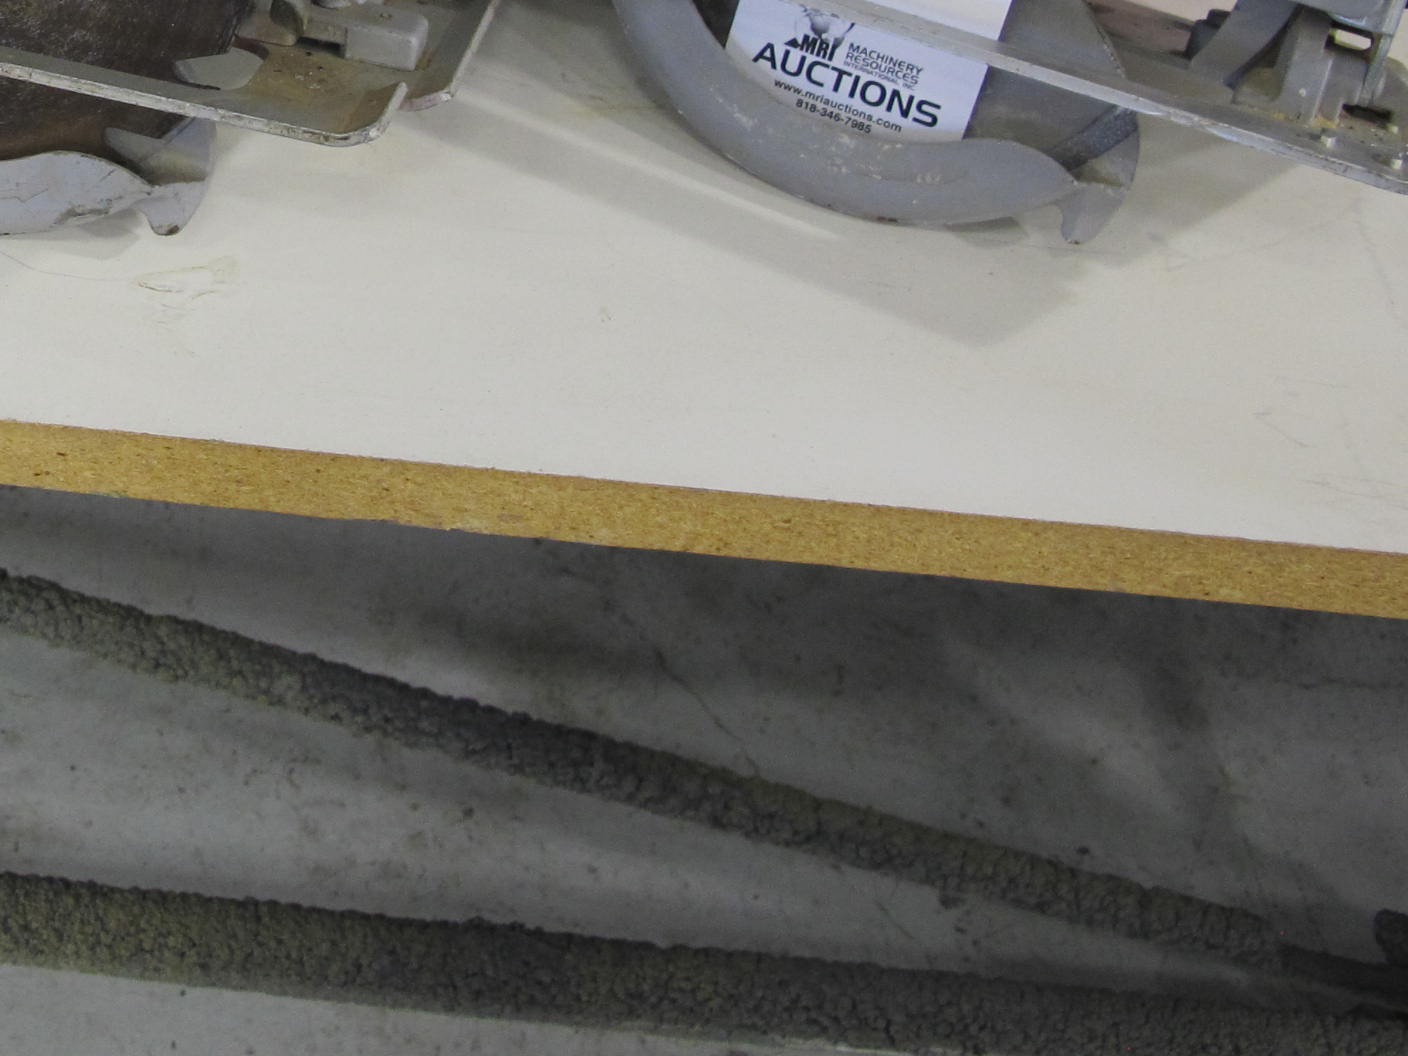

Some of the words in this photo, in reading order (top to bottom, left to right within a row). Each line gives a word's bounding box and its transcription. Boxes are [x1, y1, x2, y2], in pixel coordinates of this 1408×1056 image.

[799, 34, 842, 62] MRI
[848, 42, 924, 74] MACHINERY
[752, 42, 942, 128] AUCTIONS
[845, 51, 919, 85] RESOURCES
[773, 78, 902, 133] www.mriauctions.com
[795, 98, 872, 134] 818-346-7985
